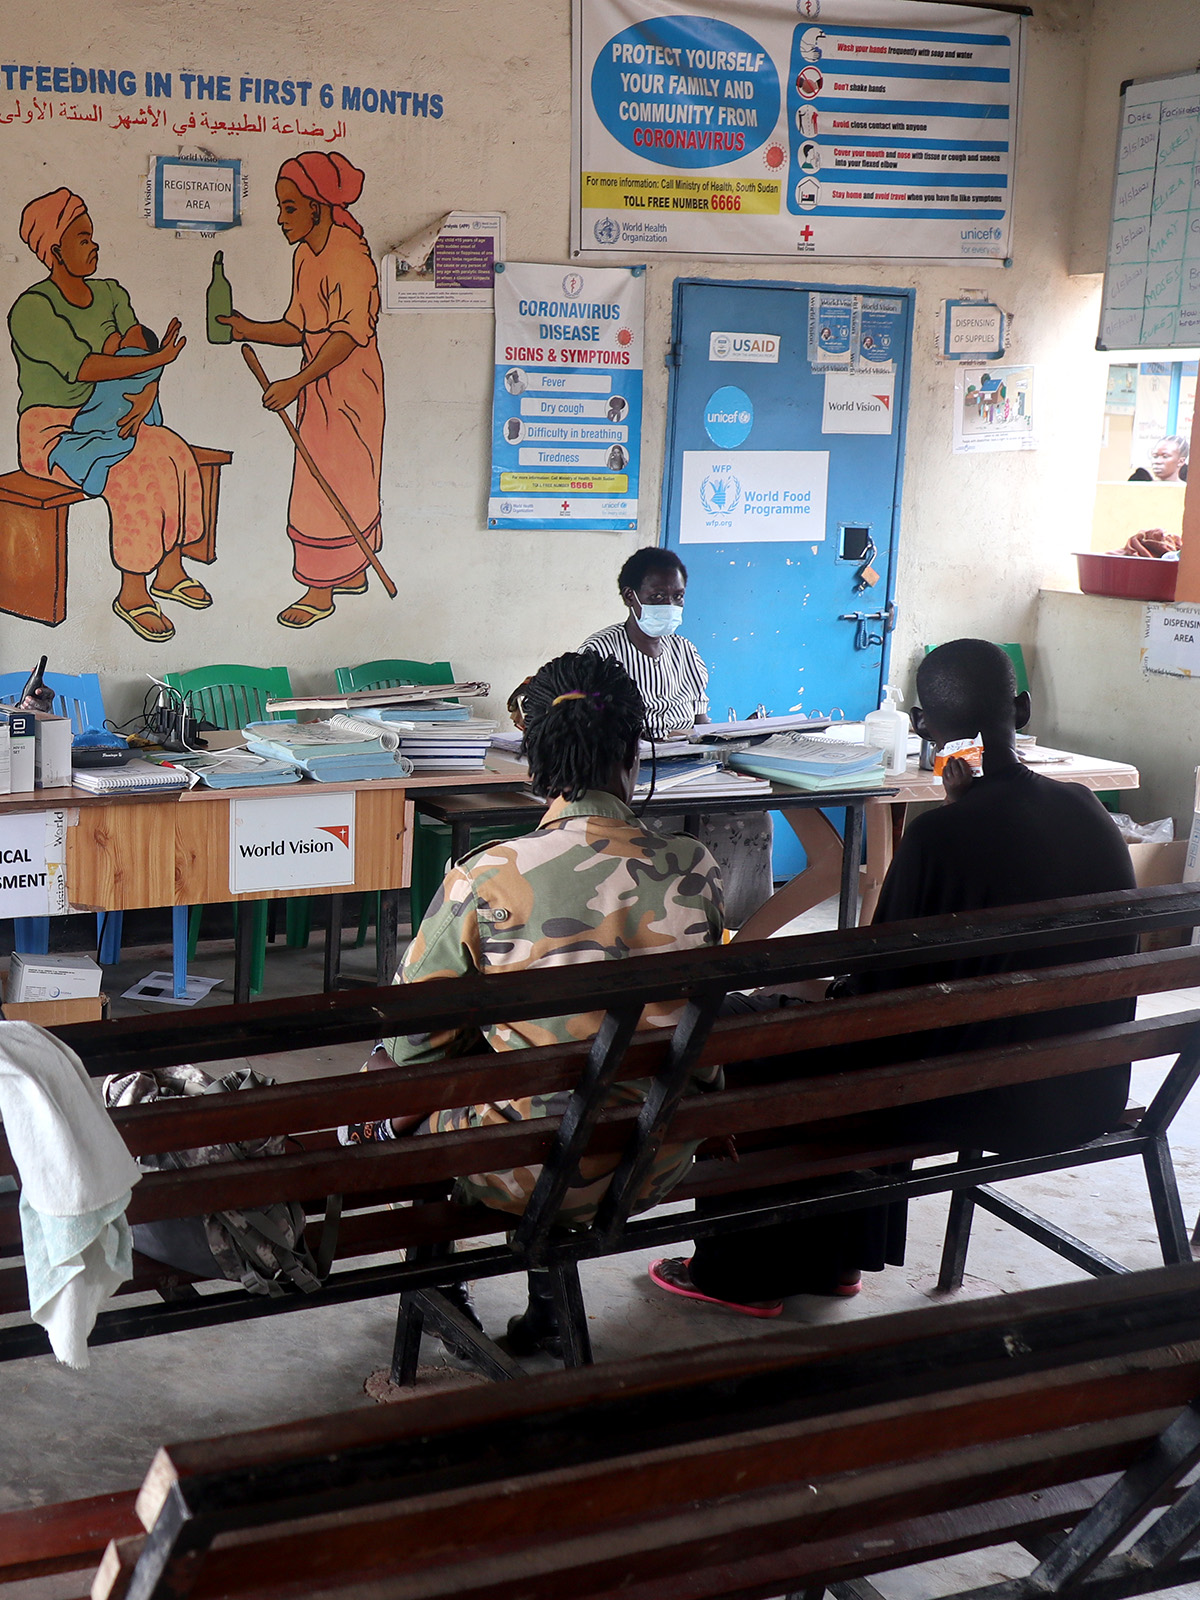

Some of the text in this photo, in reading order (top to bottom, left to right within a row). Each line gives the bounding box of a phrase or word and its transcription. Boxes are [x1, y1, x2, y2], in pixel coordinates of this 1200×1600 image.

[612, 43, 764, 72] PROTECT YOURSELF
[837, 43, 972, 59] Wash your hands frequently with soap and water
[621, 73, 754, 99] YOUR FAMILY AND
[834, 82, 886, 93] Don't shake hands
[145, 75, 171, 99] IN
[180, 73, 231, 102] THE
[239, 76, 312, 107] FIRST
[320, 83, 334, 107] 6
[342, 86, 444, 119] MONTHS
[59, 105, 102, 125] الستة
[110, 106, 167, 132] الأشهر
[619, 101, 758, 127] COMMUNITY FROM
[172, 112, 197, 135] في
[200, 112, 267, 135] الطبيعية
[271, 116, 346, 141] الرضاعة
[833, 120, 927, 132] Avoid close contact with anyone
[633, 127, 745, 151] CORONAVIRUS
[834, 148, 850, 157] Cover
[851, 150, 865, 159] your
[866, 150, 884, 158] mouth
[886, 151, 896, 159] and
[912, 152, 923, 160] with
[924, 152, 940, 160] tissue
[948, 153, 966, 162] cough
[967, 153, 978, 161] and
[164, 180, 232, 192] REGISTRATION
[587, 176, 778, 193] For more information: Call Ministry of Health, South Sudan
[624, 194, 741, 211] TOLL FREE NUMBER 6666
[832, 190, 845, 200] Stay
[846, 191, 862, 199] home
[875, 192, 889, 200] avoid
[890, 192, 906, 201] travel
[907, 193, 923, 201] when
[924, 195, 934, 203] you
[936, 194, 949, 202] have
[950, 193, 958, 202] flu
[959, 194, 971, 202] like
[972, 195, 1002, 203] symptoms
[185, 200, 211, 209] AREA
[622, 222, 667, 233] World Health
[961, 228, 992, 240] unicef
[622, 232, 667, 243] Organization
[519, 300, 620, 320] CORONAVIRUS
[955, 319, 995, 327] DISPENSING
[539, 324, 600, 342] DISEASE
[733, 339, 775, 353] USAID
[505, 347, 630, 365] SIGNS & SYMPTOMS
[542, 376, 565, 387] Fever
[541, 402, 584, 416] Dry cough
[828, 402, 881, 411] World Vision
[708, 410, 739, 423] unicef
[528, 427, 622, 442] Difficulty in breathing
[538, 452, 580, 463] Tiredness
[712, 465, 732, 473] WFP
[744, 491, 811, 501] World Food
[744, 504, 810, 517] Programme
[706, 520, 733, 528] wfp.org
[1174, 634, 1194, 643] AREA
[239, 838, 333, 858] World Vision
